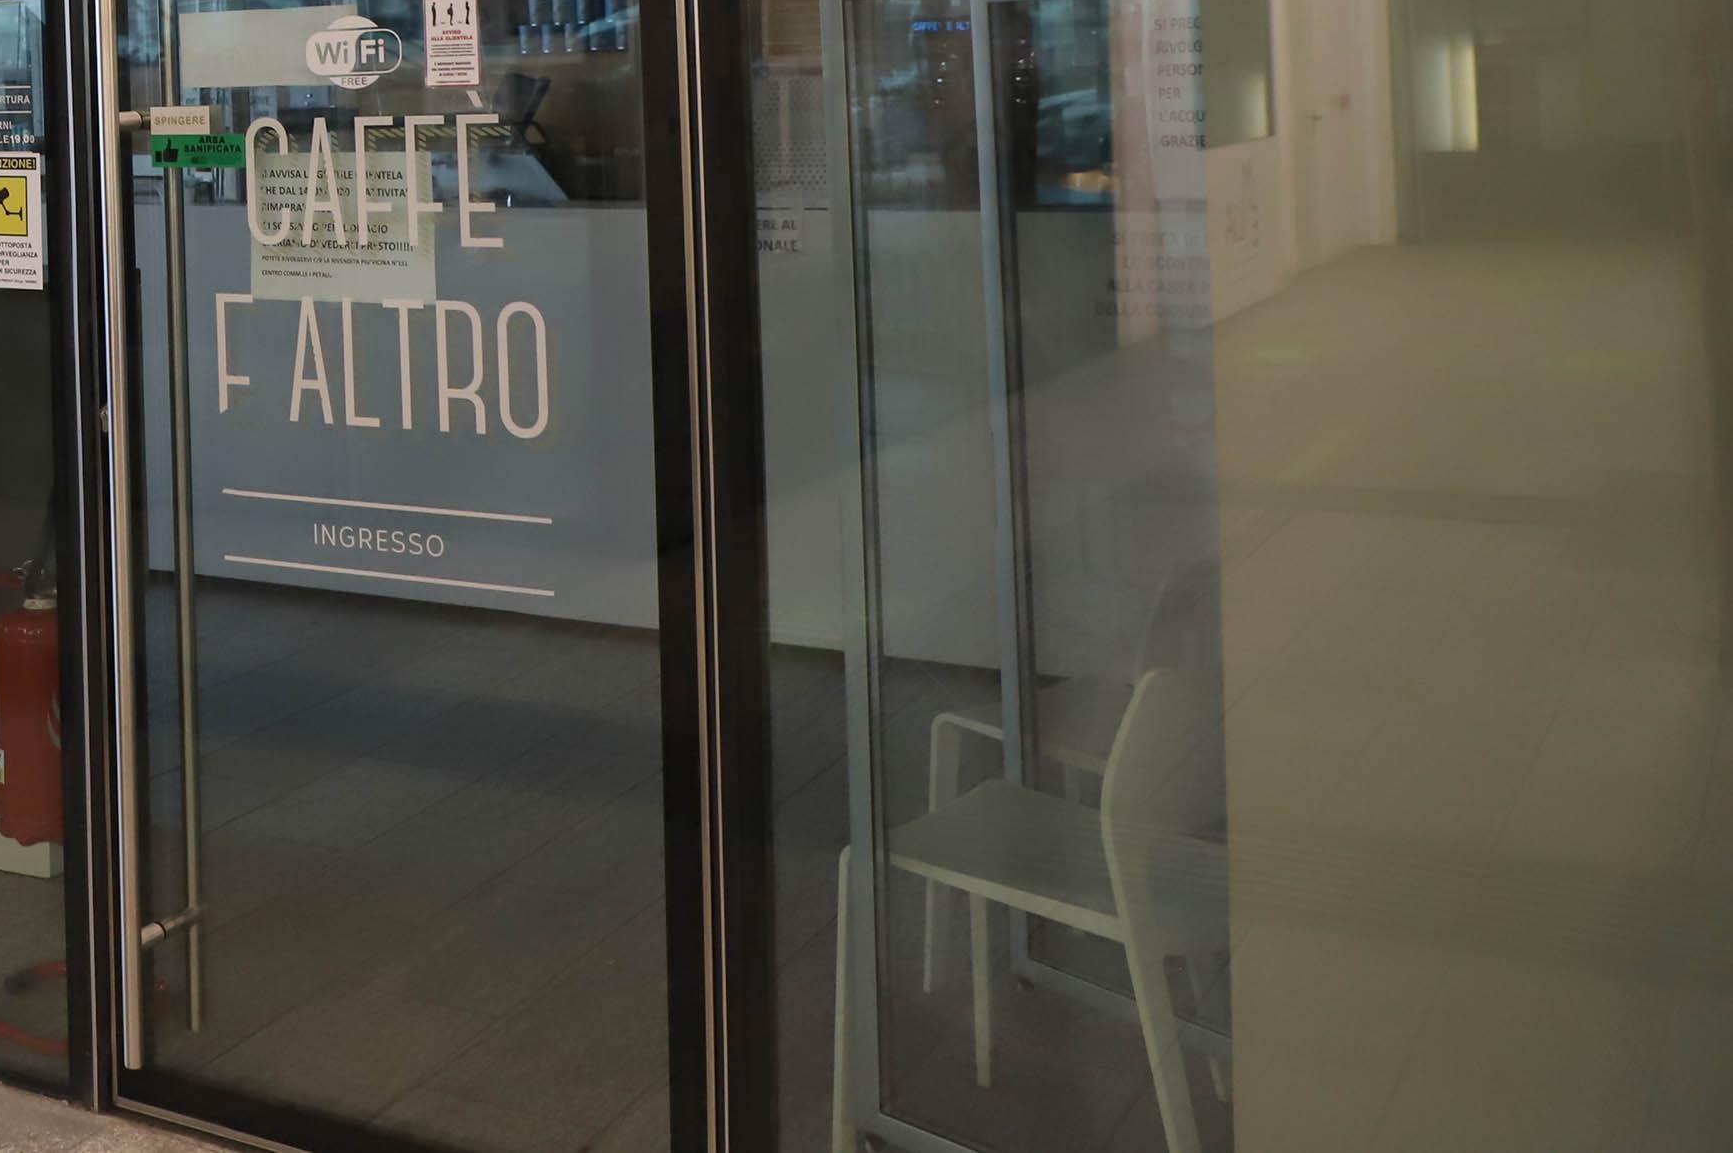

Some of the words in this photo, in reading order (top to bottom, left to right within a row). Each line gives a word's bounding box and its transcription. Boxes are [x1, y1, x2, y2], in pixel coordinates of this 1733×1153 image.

[340, 75, 369, 87] FREE
[154, 115, 206, 126] SPINGERE
[199, 135, 225, 144] AREA
[246, 91, 504, 248] CAFFÈ
[4, 268, 37, 276] SICUREZZA
[289, 296, 549, 439] ALTRO
[313, 522, 445, 558] INGRESSO
